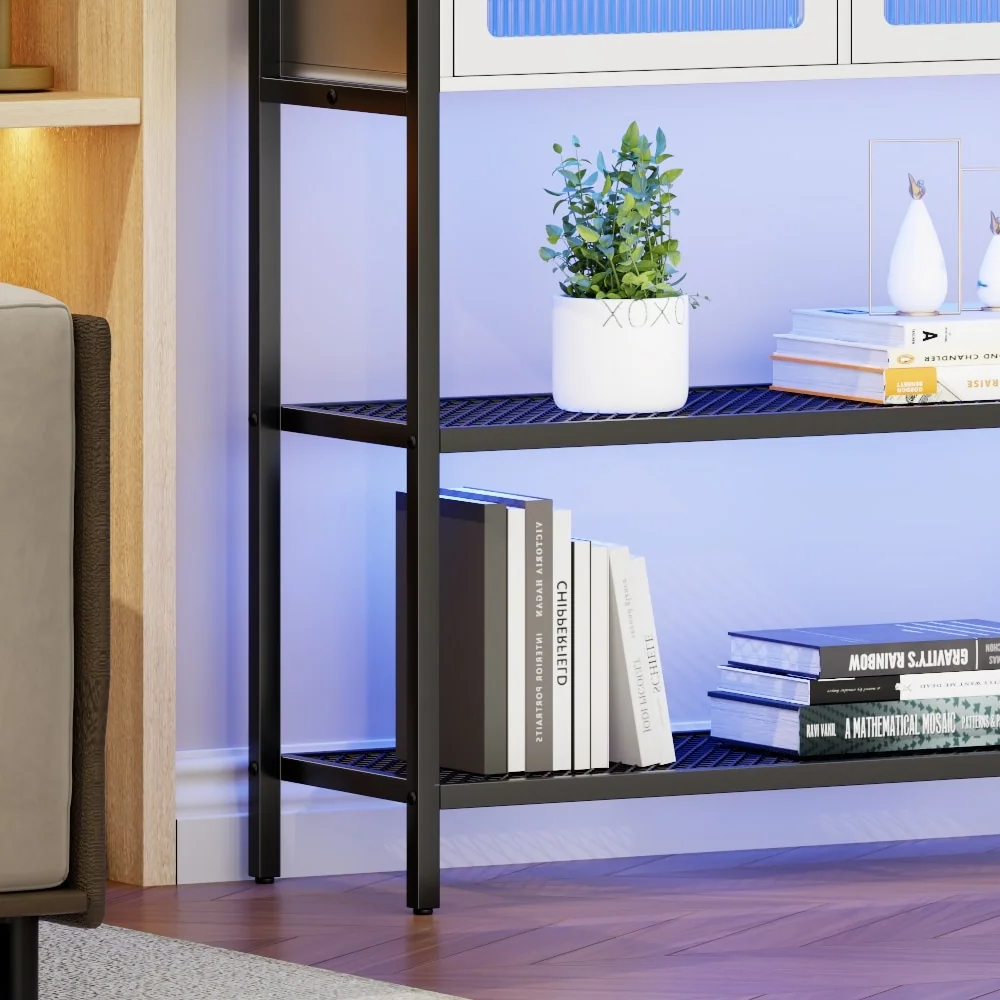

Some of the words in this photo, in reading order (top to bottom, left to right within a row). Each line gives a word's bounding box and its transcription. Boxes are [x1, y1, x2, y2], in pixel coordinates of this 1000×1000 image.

[602, 297, 685, 328] XOXO
[922, 330, 938, 342] A
[924, 354, 979, 362] CHANDLER
[967, 379, 999, 388] RAISE
[848, 651, 905, 671] RAINBOW
[908, 648, 969, 668] GRAVITY'S
[845, 717, 851, 739] A
[853, 714, 920, 739] MATHEMATICAL
[922, 711, 956, 735] MOSAIC
[962, 714, 989, 729] PATTERNS
[990, 714, 995, 727] &
[806, 723, 820, 738] RAVI
